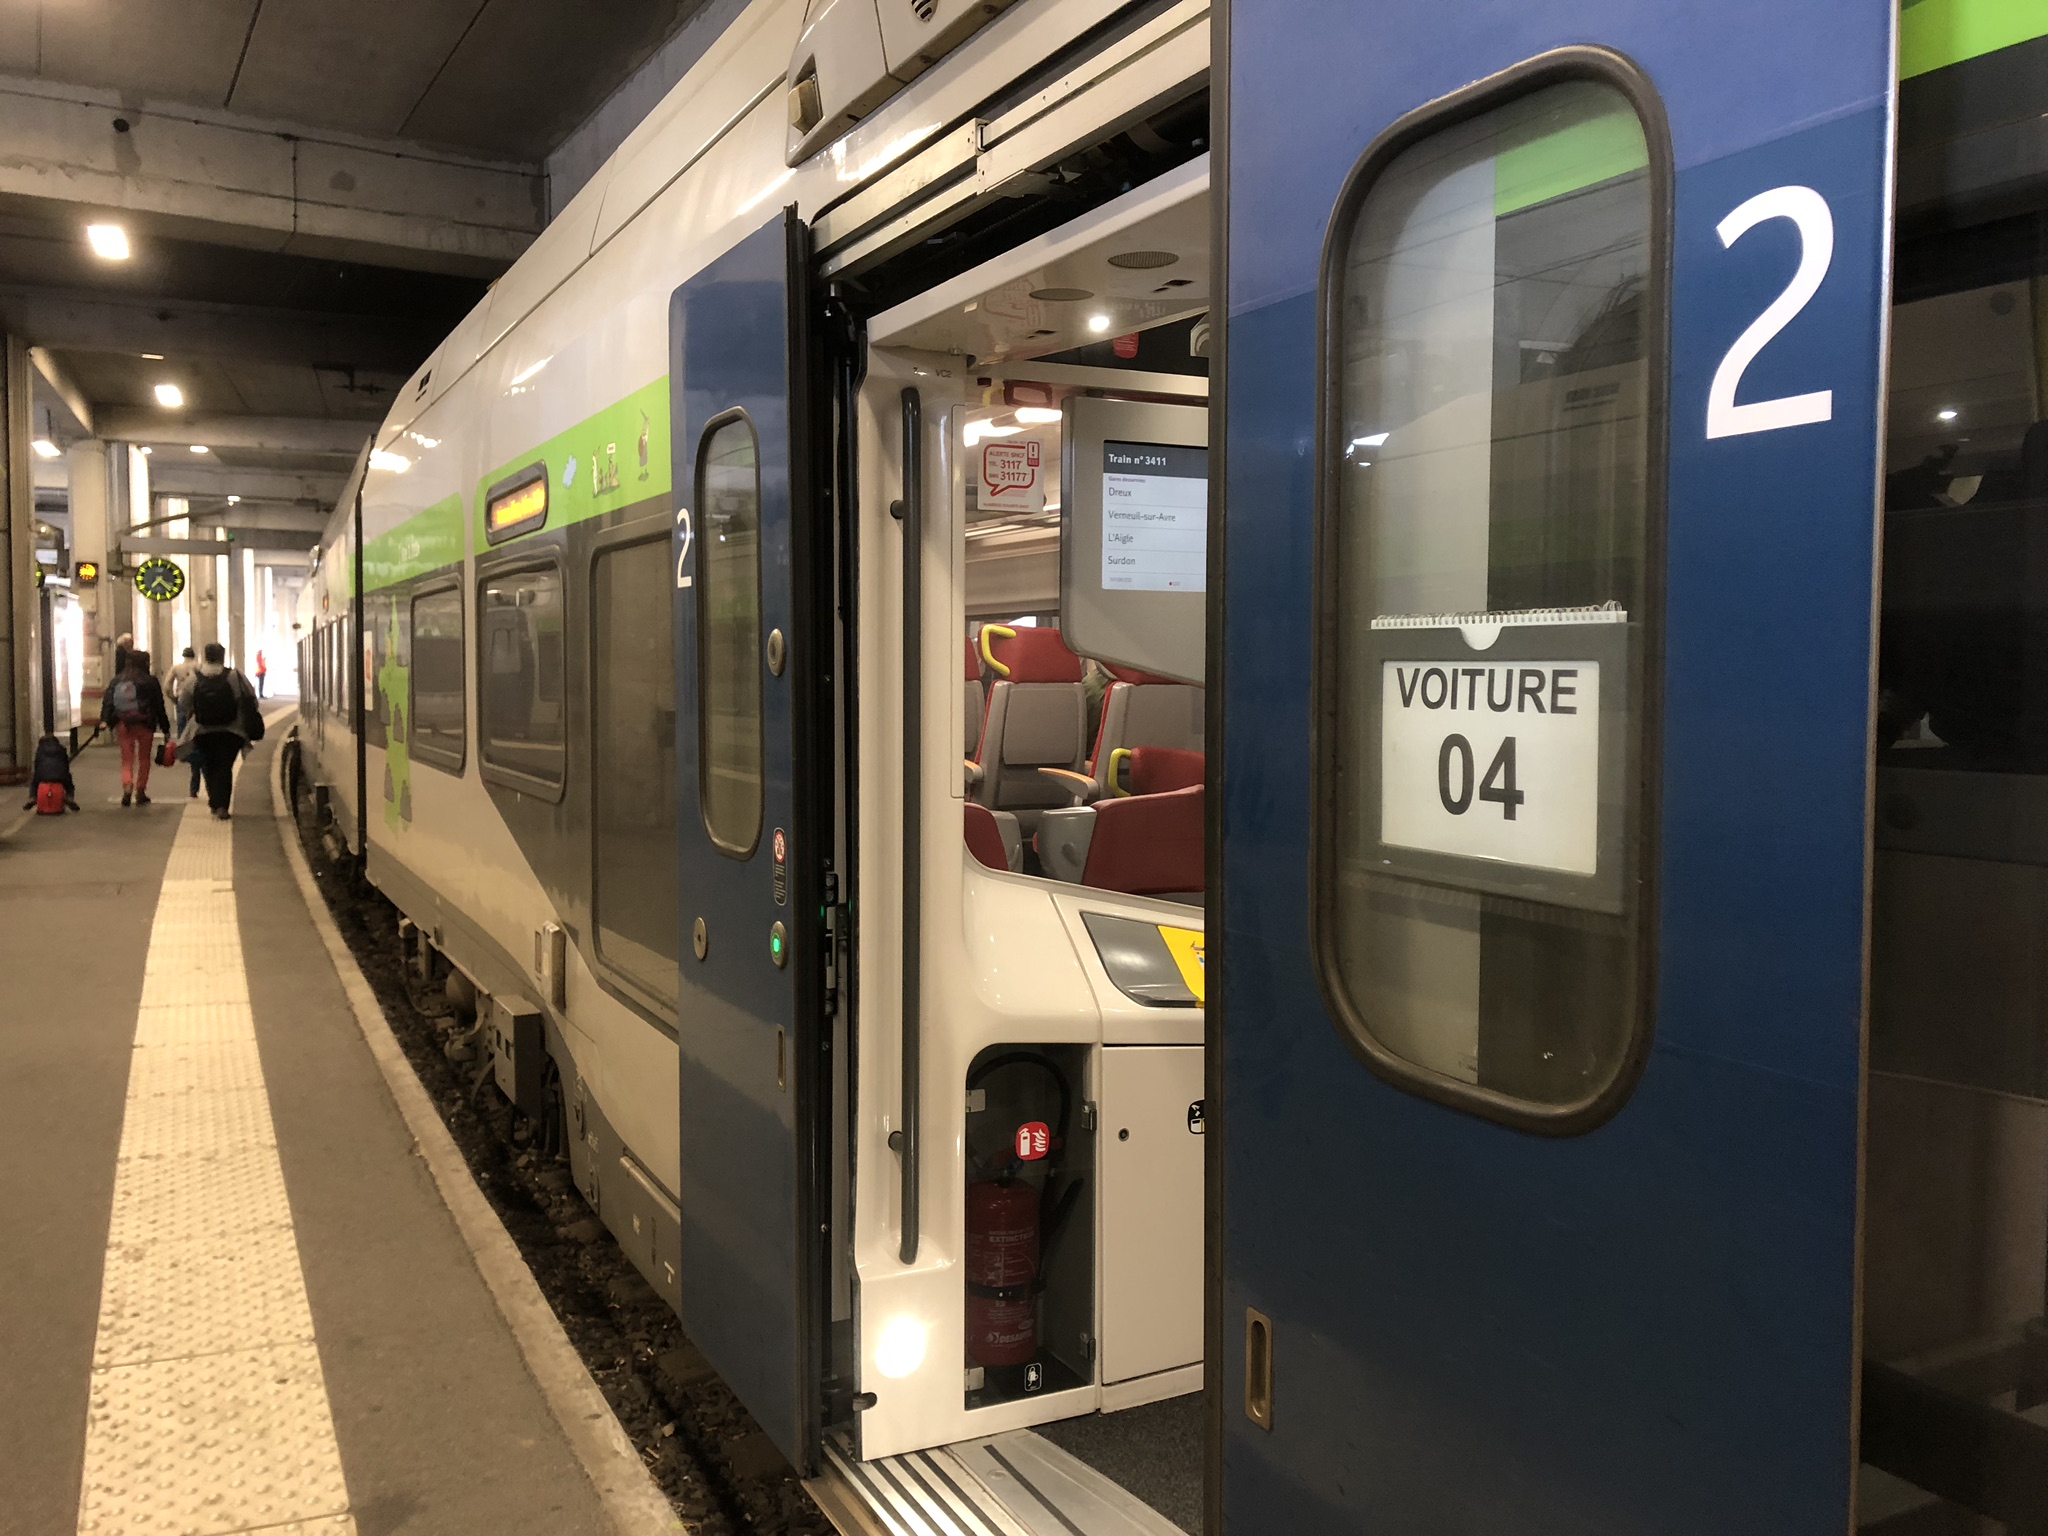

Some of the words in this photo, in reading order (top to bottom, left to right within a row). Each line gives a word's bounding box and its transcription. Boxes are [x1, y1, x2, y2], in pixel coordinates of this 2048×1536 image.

[1706, 185, 1834, 440] 2
[1000, 459, 1022, 470] 3117
[1108, 454, 1132, 464] Train
[1145, 456, 1167, 466] 3411
[1000, 471, 1027, 482] 31177
[1108, 487, 1132, 497] Dreux
[1108, 510, 1176, 522] Verneuil-sur-Avre
[1108, 533, 1134, 544] L'Aigle
[677, 508, 692, 588] 2
[1107, 555, 1136, 565] Surdon
[1396, 667, 1579, 715] VOITURE
[1438, 733, 1525, 821] 04
